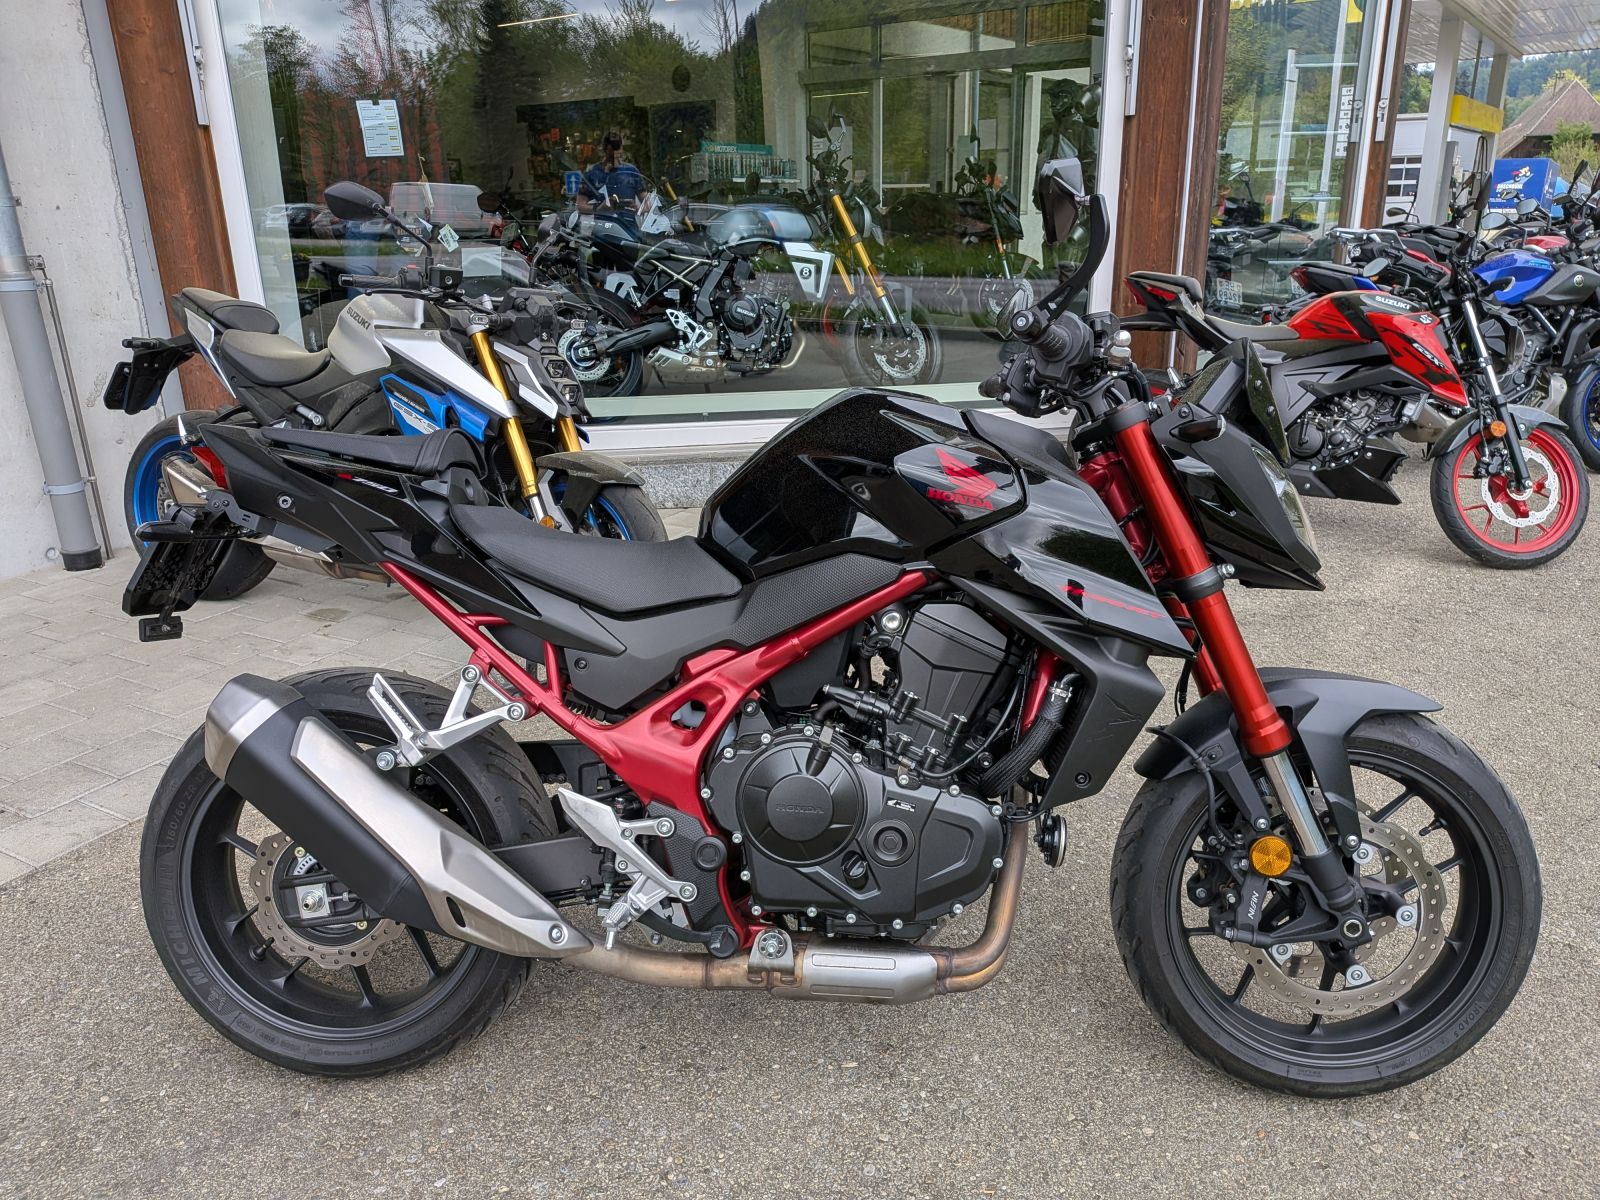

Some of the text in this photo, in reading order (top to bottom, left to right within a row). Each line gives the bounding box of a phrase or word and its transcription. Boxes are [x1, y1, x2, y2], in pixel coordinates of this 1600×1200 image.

[736, 306, 757, 318] SUZUKI
[1375, 295, 1411, 310] SUZUKI
[346, 306, 371, 330] SUZUKI
[927, 486, 993, 511] HONDA
[775, 802, 825, 815] HONDA
[159, 866, 209, 986] MICHELIN
